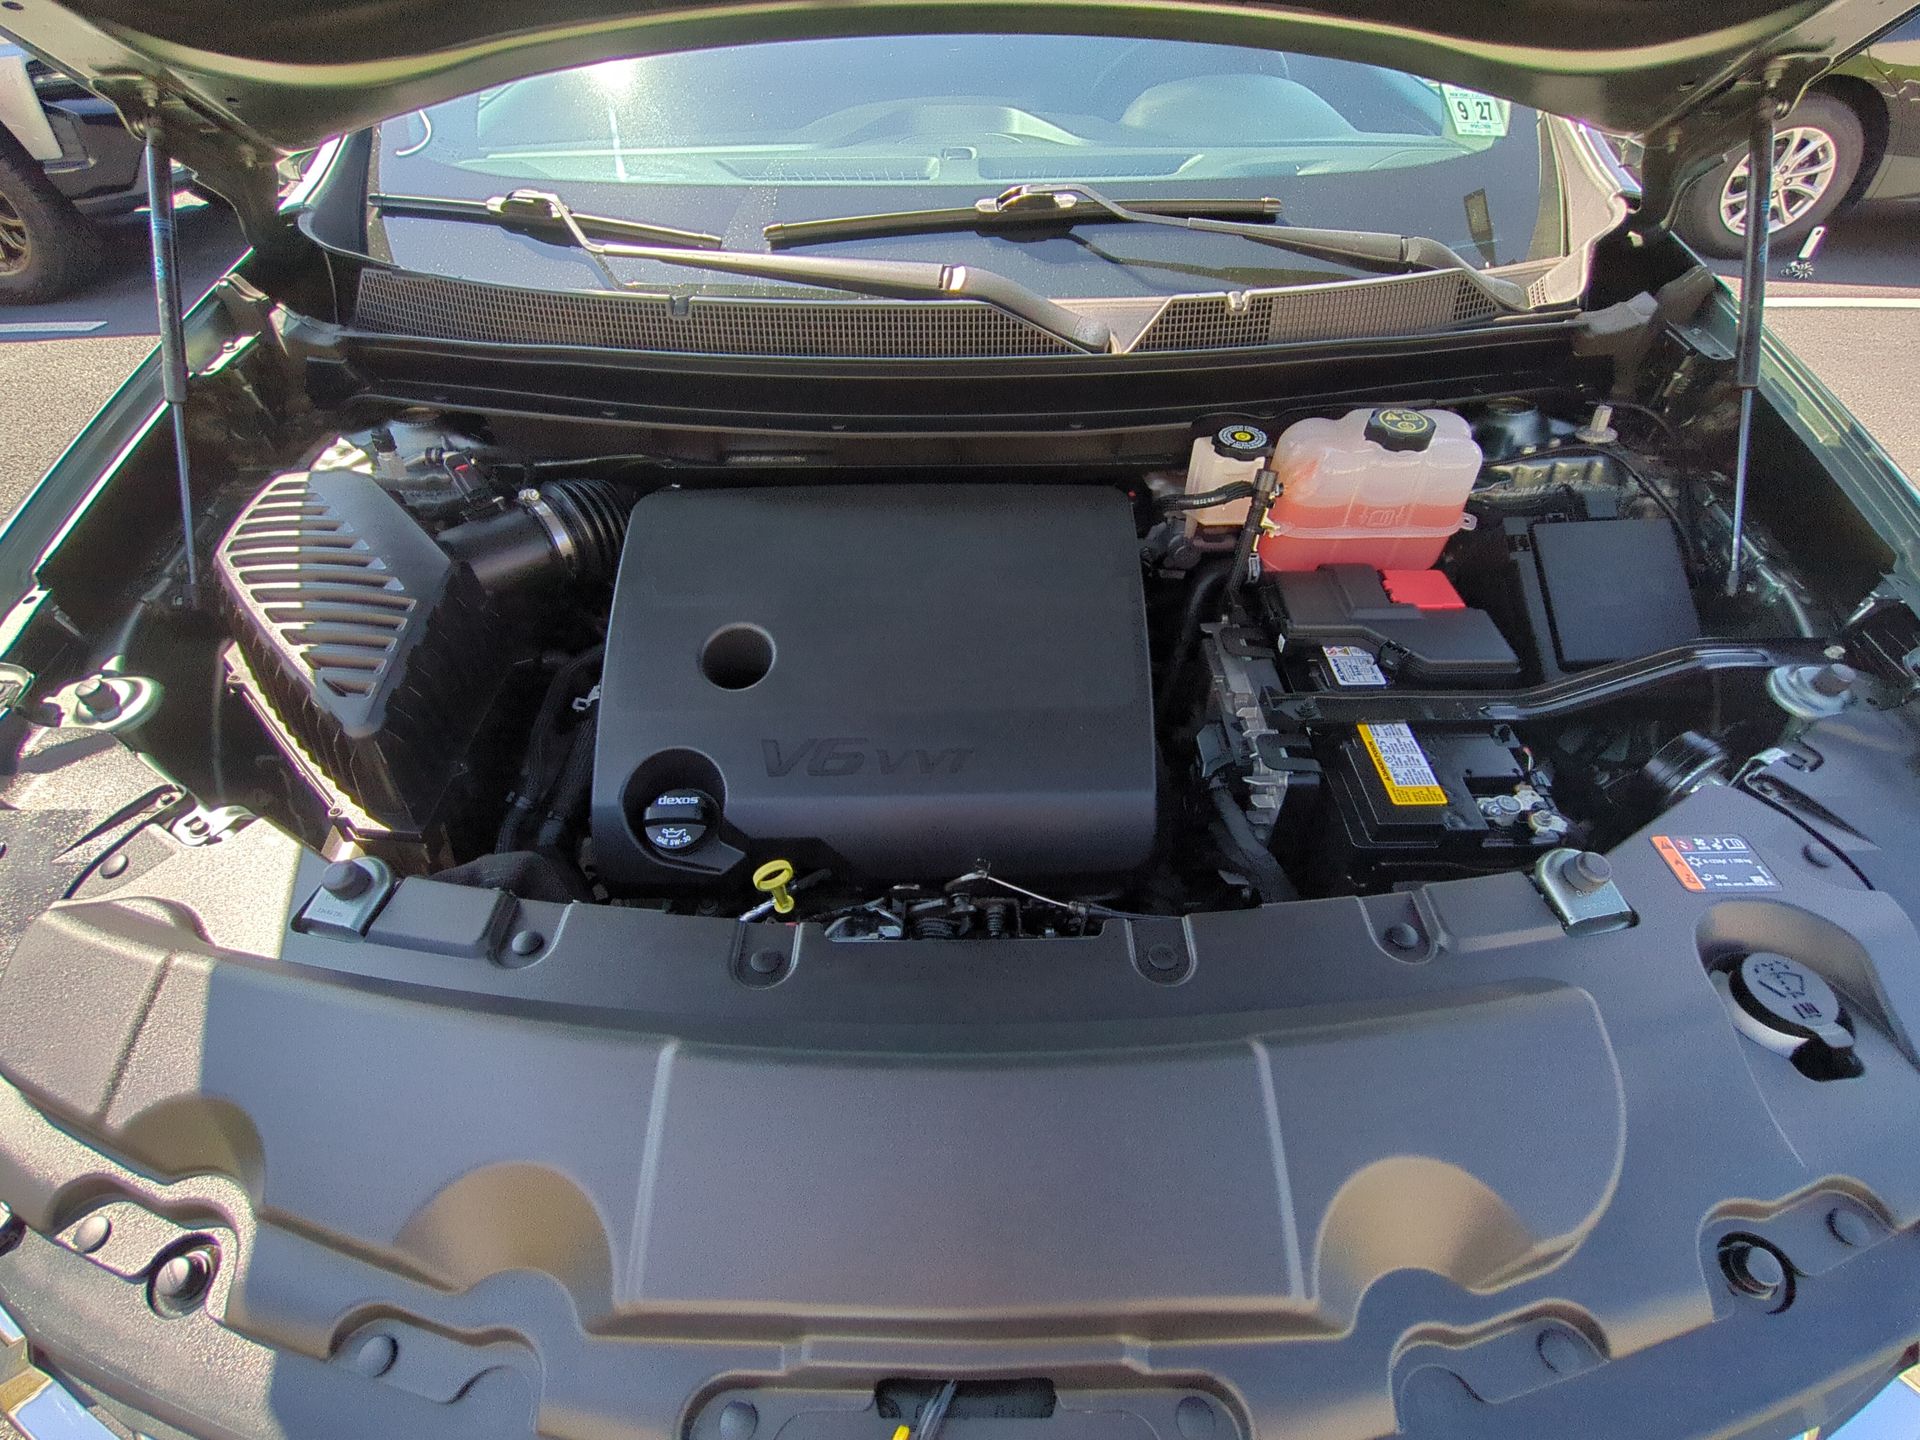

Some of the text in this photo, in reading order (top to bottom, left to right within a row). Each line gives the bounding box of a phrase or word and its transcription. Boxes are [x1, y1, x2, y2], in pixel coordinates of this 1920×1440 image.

[1457, 101, 1493, 120] 9 27
[761, 738, 975, 777] V6 VVT
[657, 795, 700, 805] dexos
[656, 836, 691, 846] SAE 5W-30
